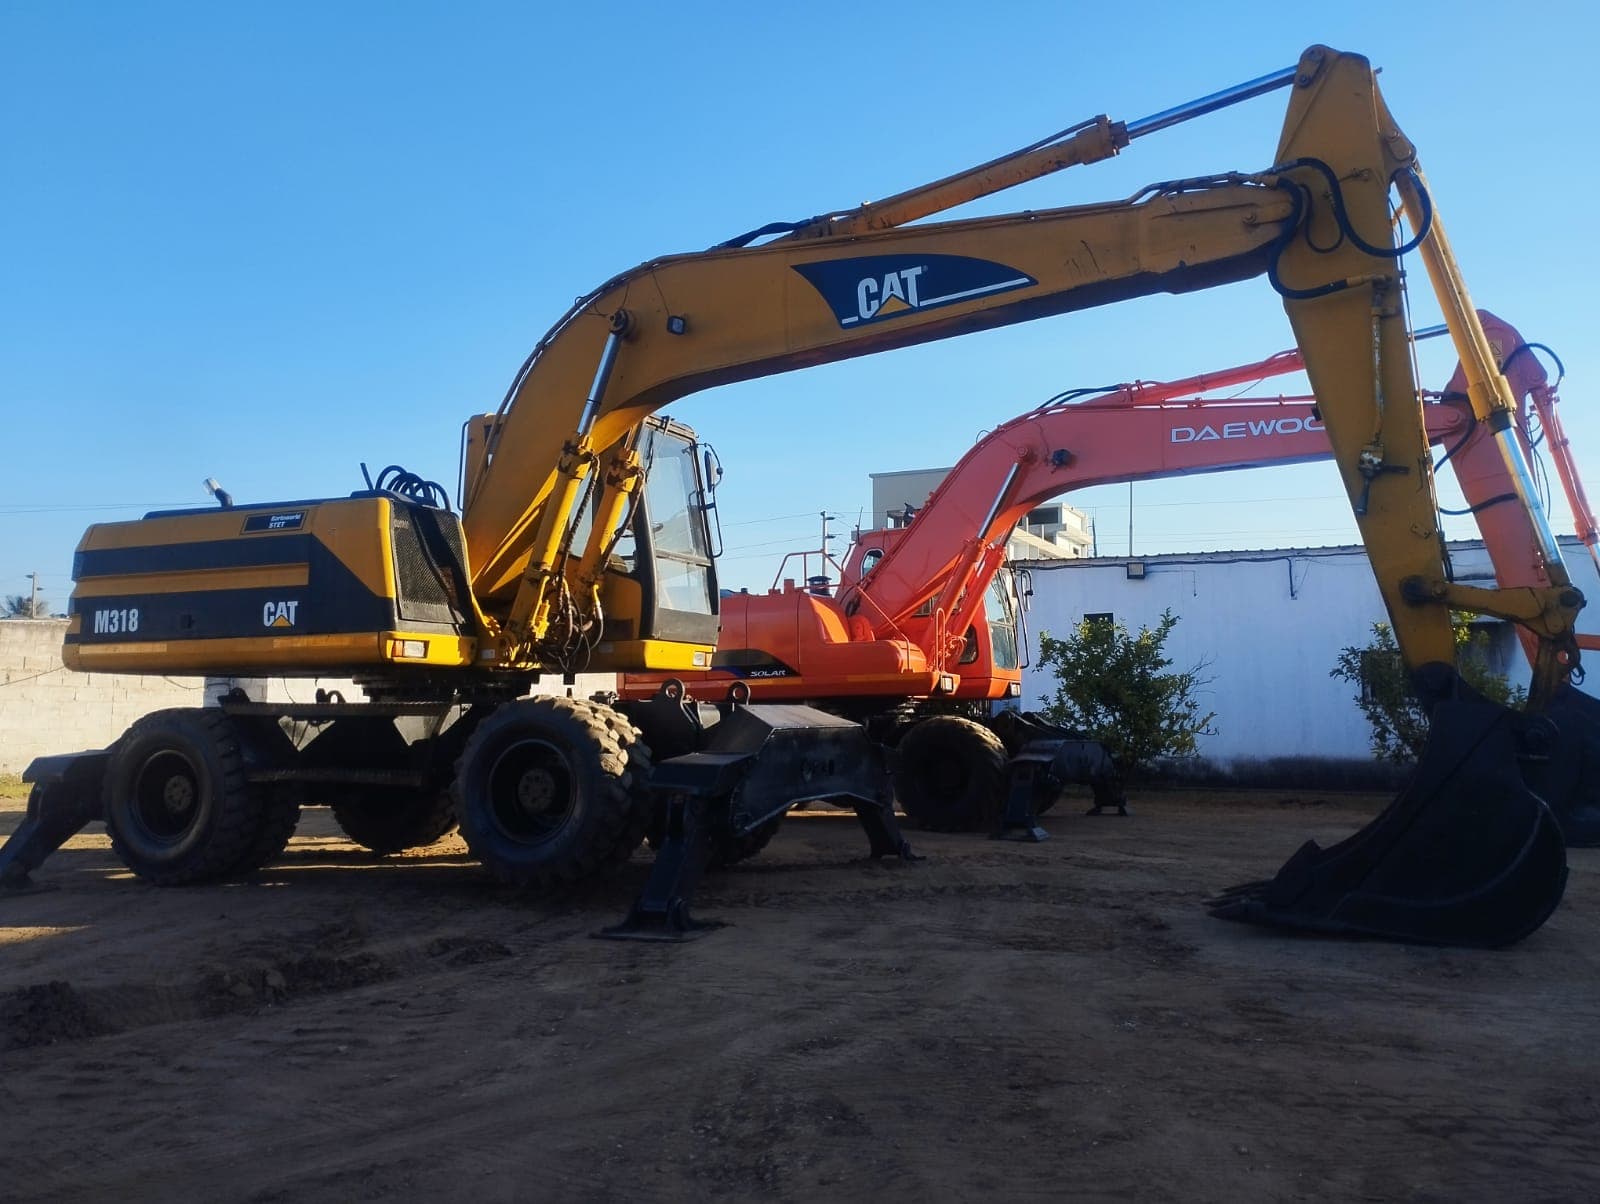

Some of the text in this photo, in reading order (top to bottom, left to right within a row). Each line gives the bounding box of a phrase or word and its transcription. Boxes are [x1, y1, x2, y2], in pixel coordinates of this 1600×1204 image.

[858, 266, 922, 319] CAT
[94, 609, 139, 634] M318
[263, 601, 299, 627] CAT
